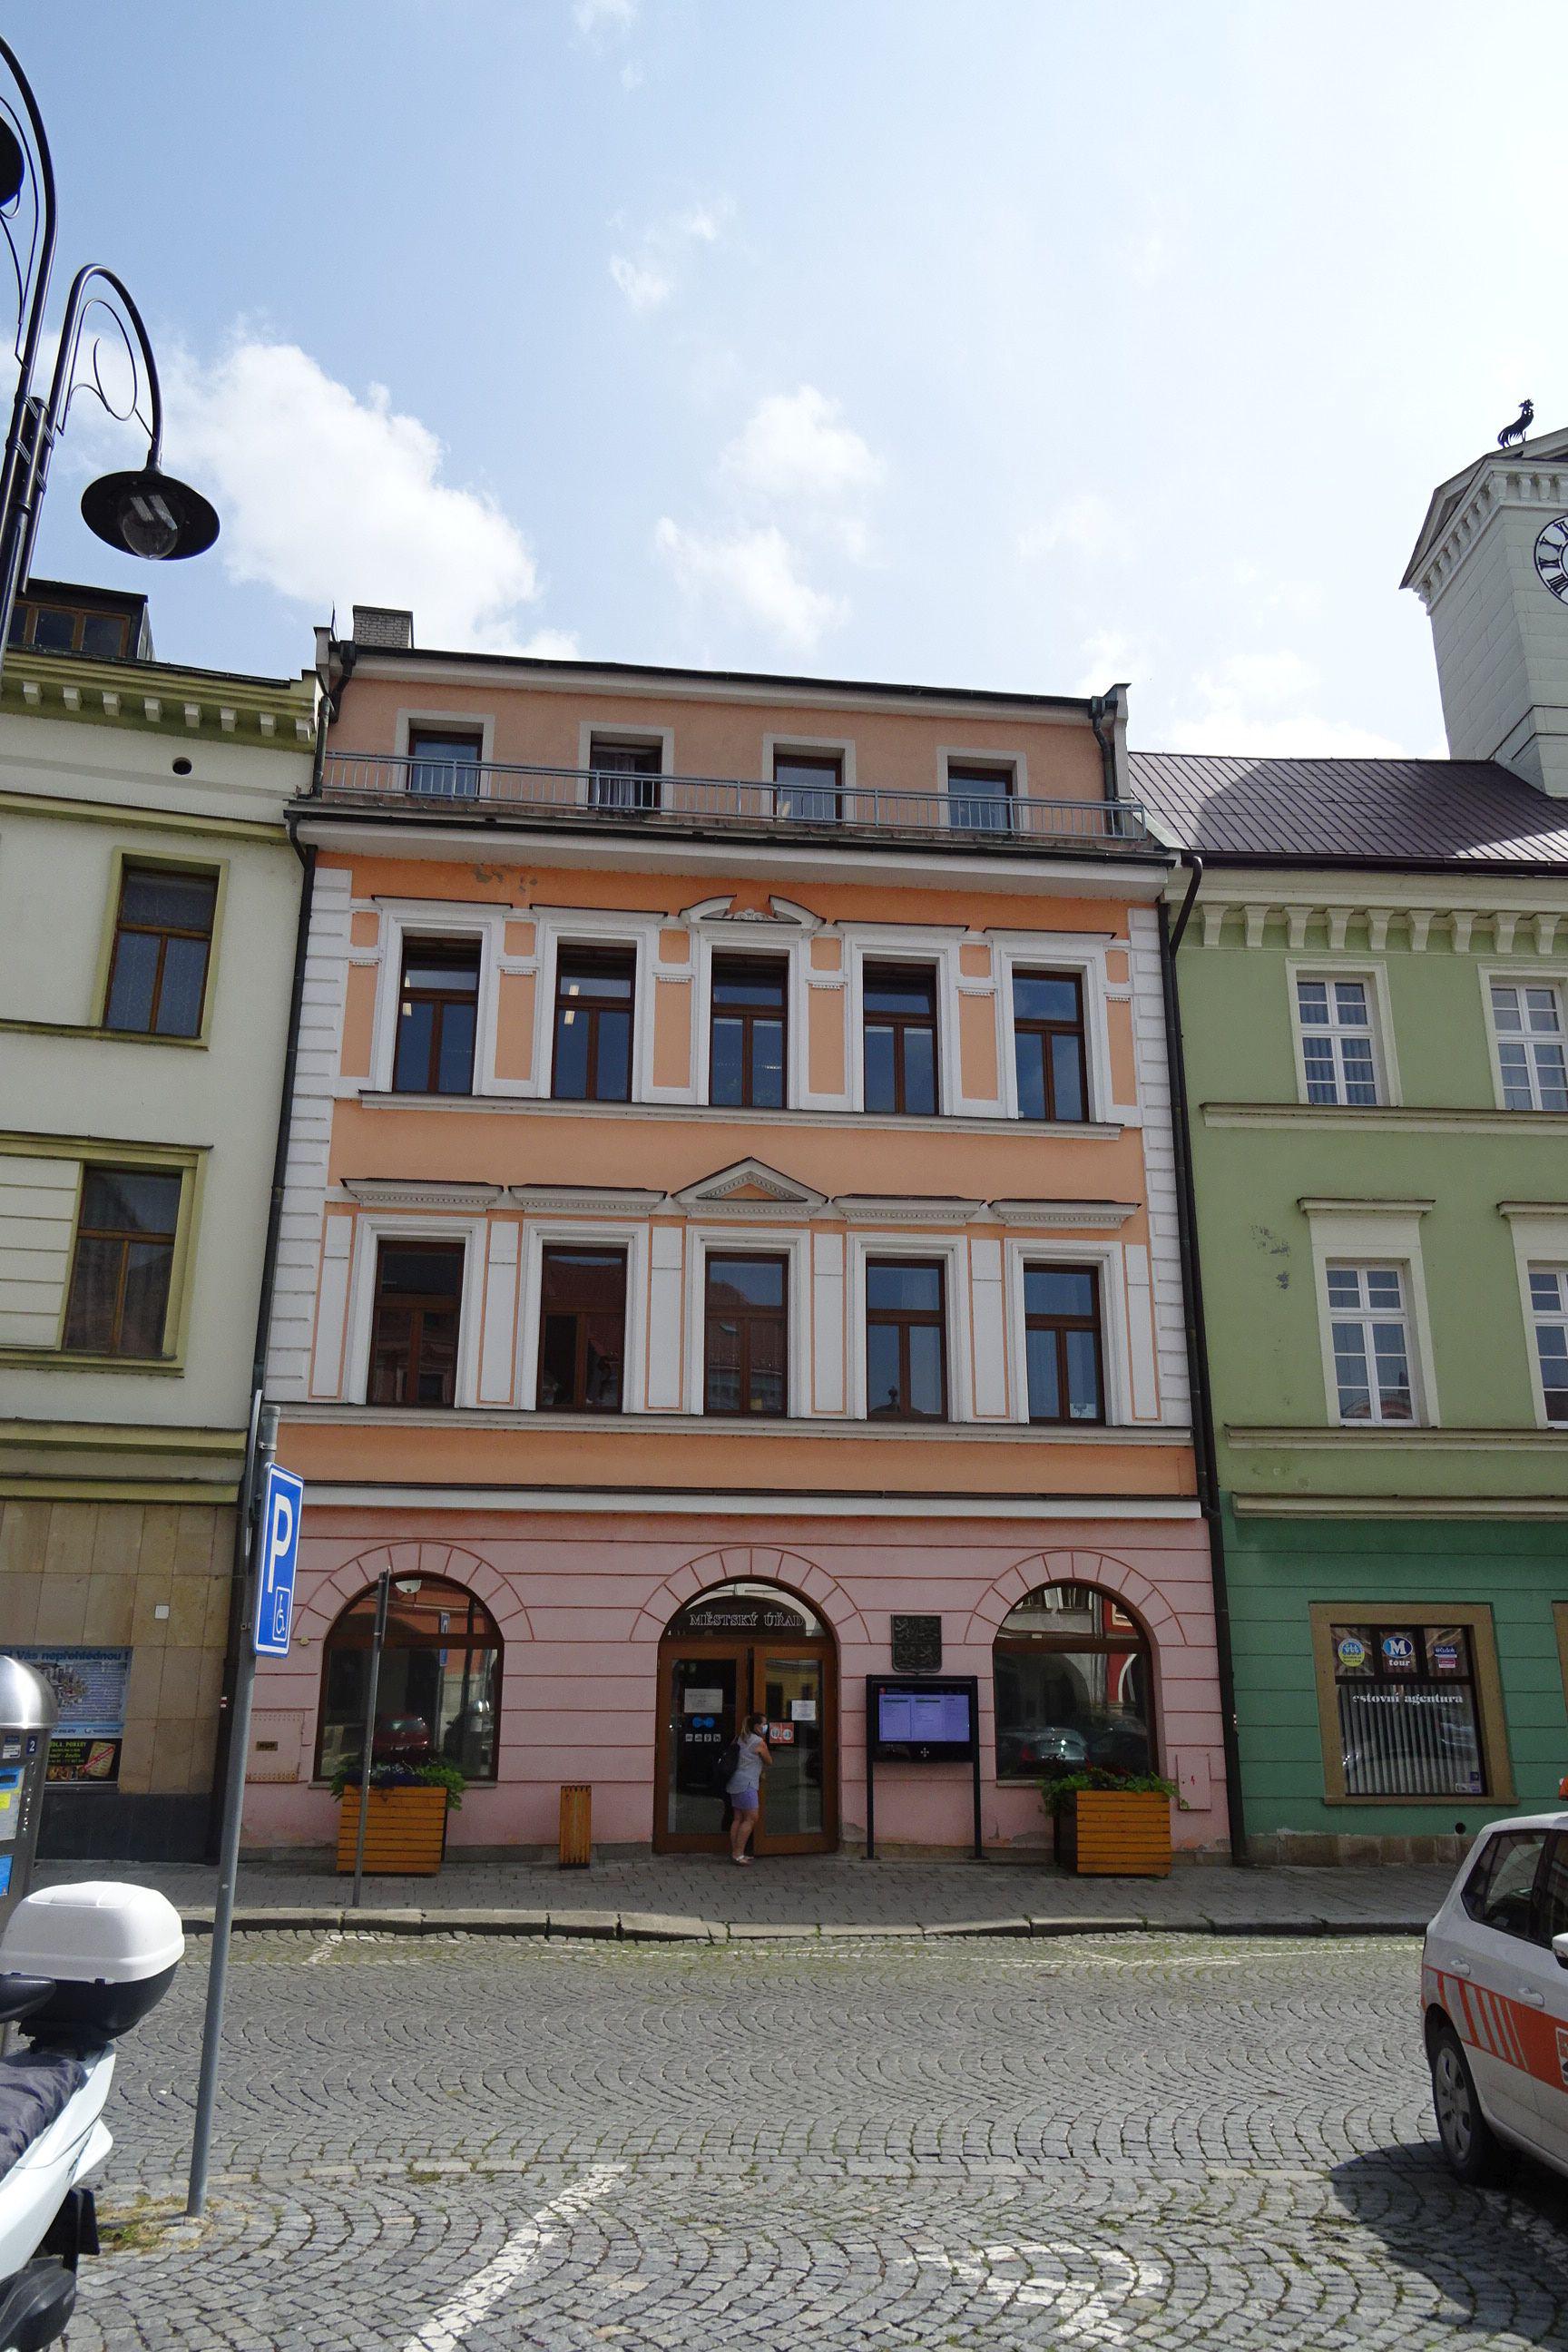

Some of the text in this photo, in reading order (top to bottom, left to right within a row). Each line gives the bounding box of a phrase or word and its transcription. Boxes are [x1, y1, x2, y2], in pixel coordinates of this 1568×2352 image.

[267, 1493, 293, 1593] P
[690, 1611, 804, 1627] MĚSTSKÝ ÚŘAD
[1389, 1640, 1407, 1654] M
[1388, 1658, 1411, 1667] tour
[1404, 1694, 1463, 1706] agentura
[29, 1740, 36, 1752] 2
